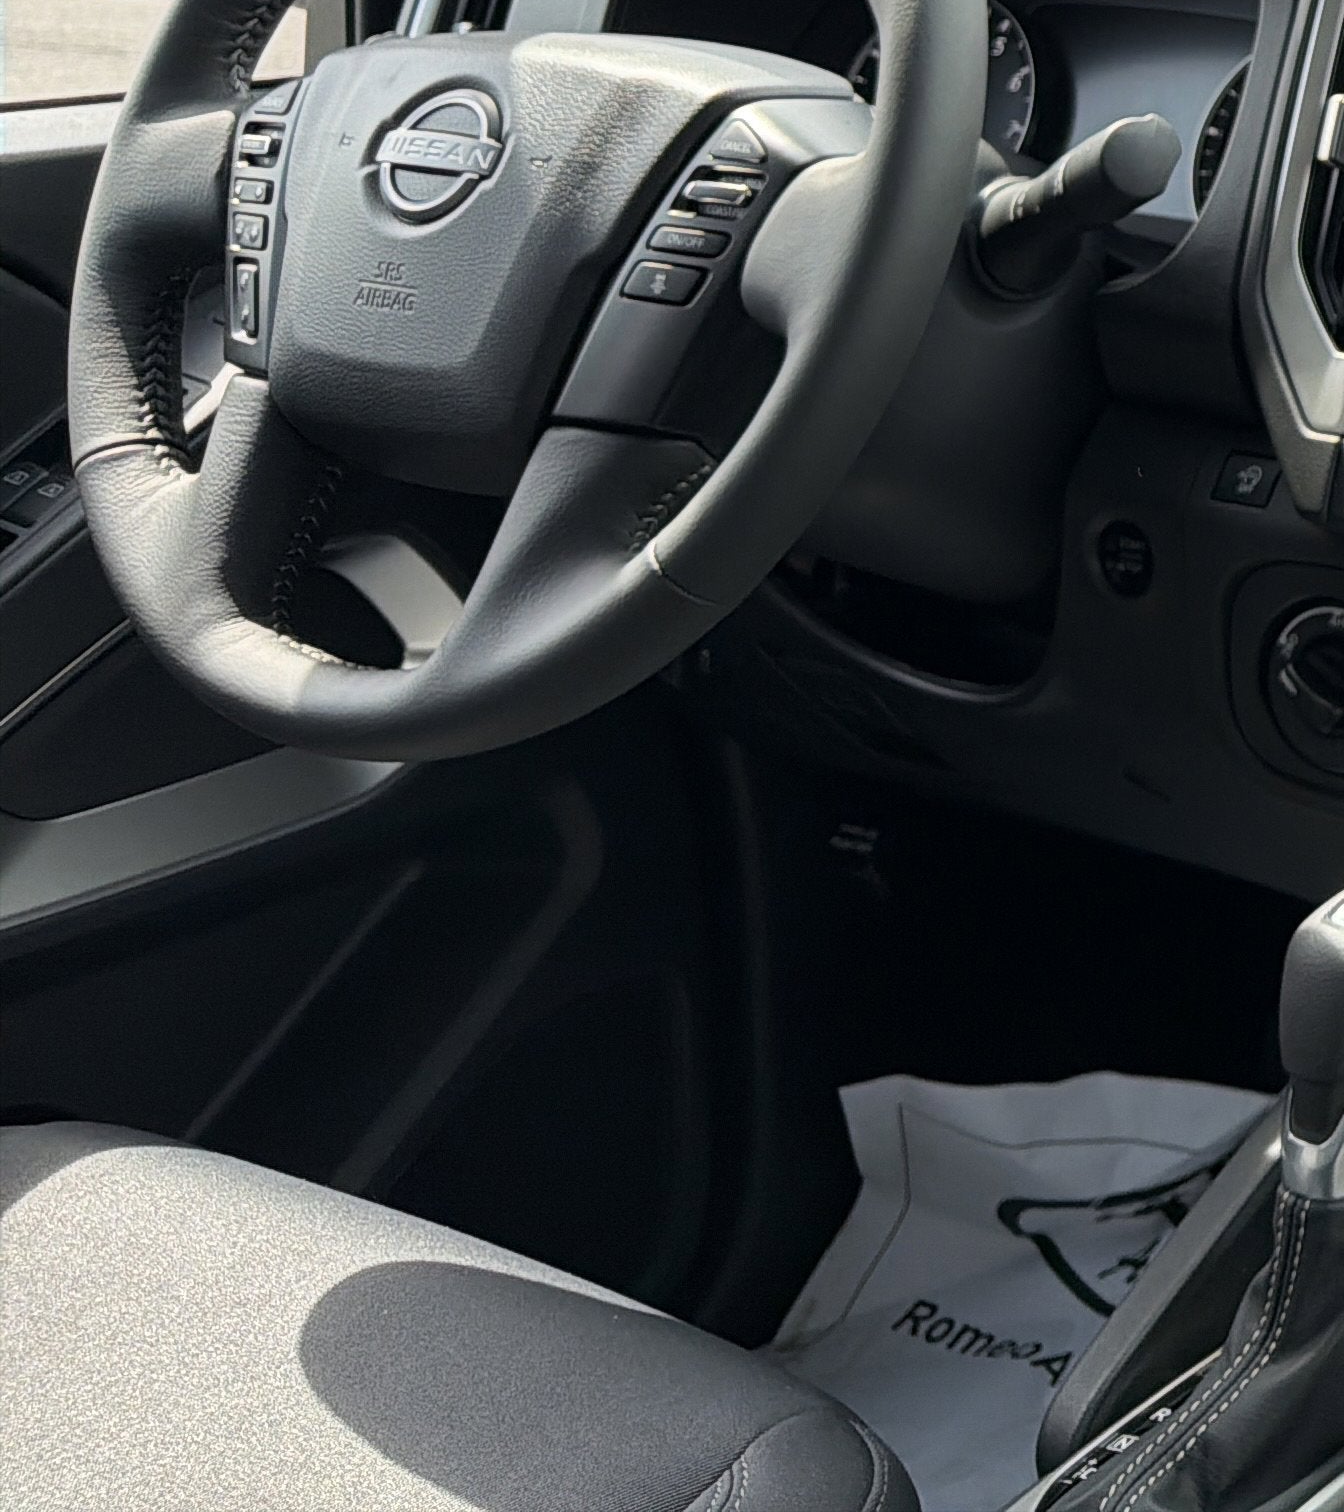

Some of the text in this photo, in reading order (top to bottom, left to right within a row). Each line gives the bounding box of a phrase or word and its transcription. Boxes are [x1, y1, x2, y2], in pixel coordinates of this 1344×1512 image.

[387, 135, 497, 171] NISSAN
[373, 260, 406, 282] SRS
[353, 286, 418, 312] AIRBAG
